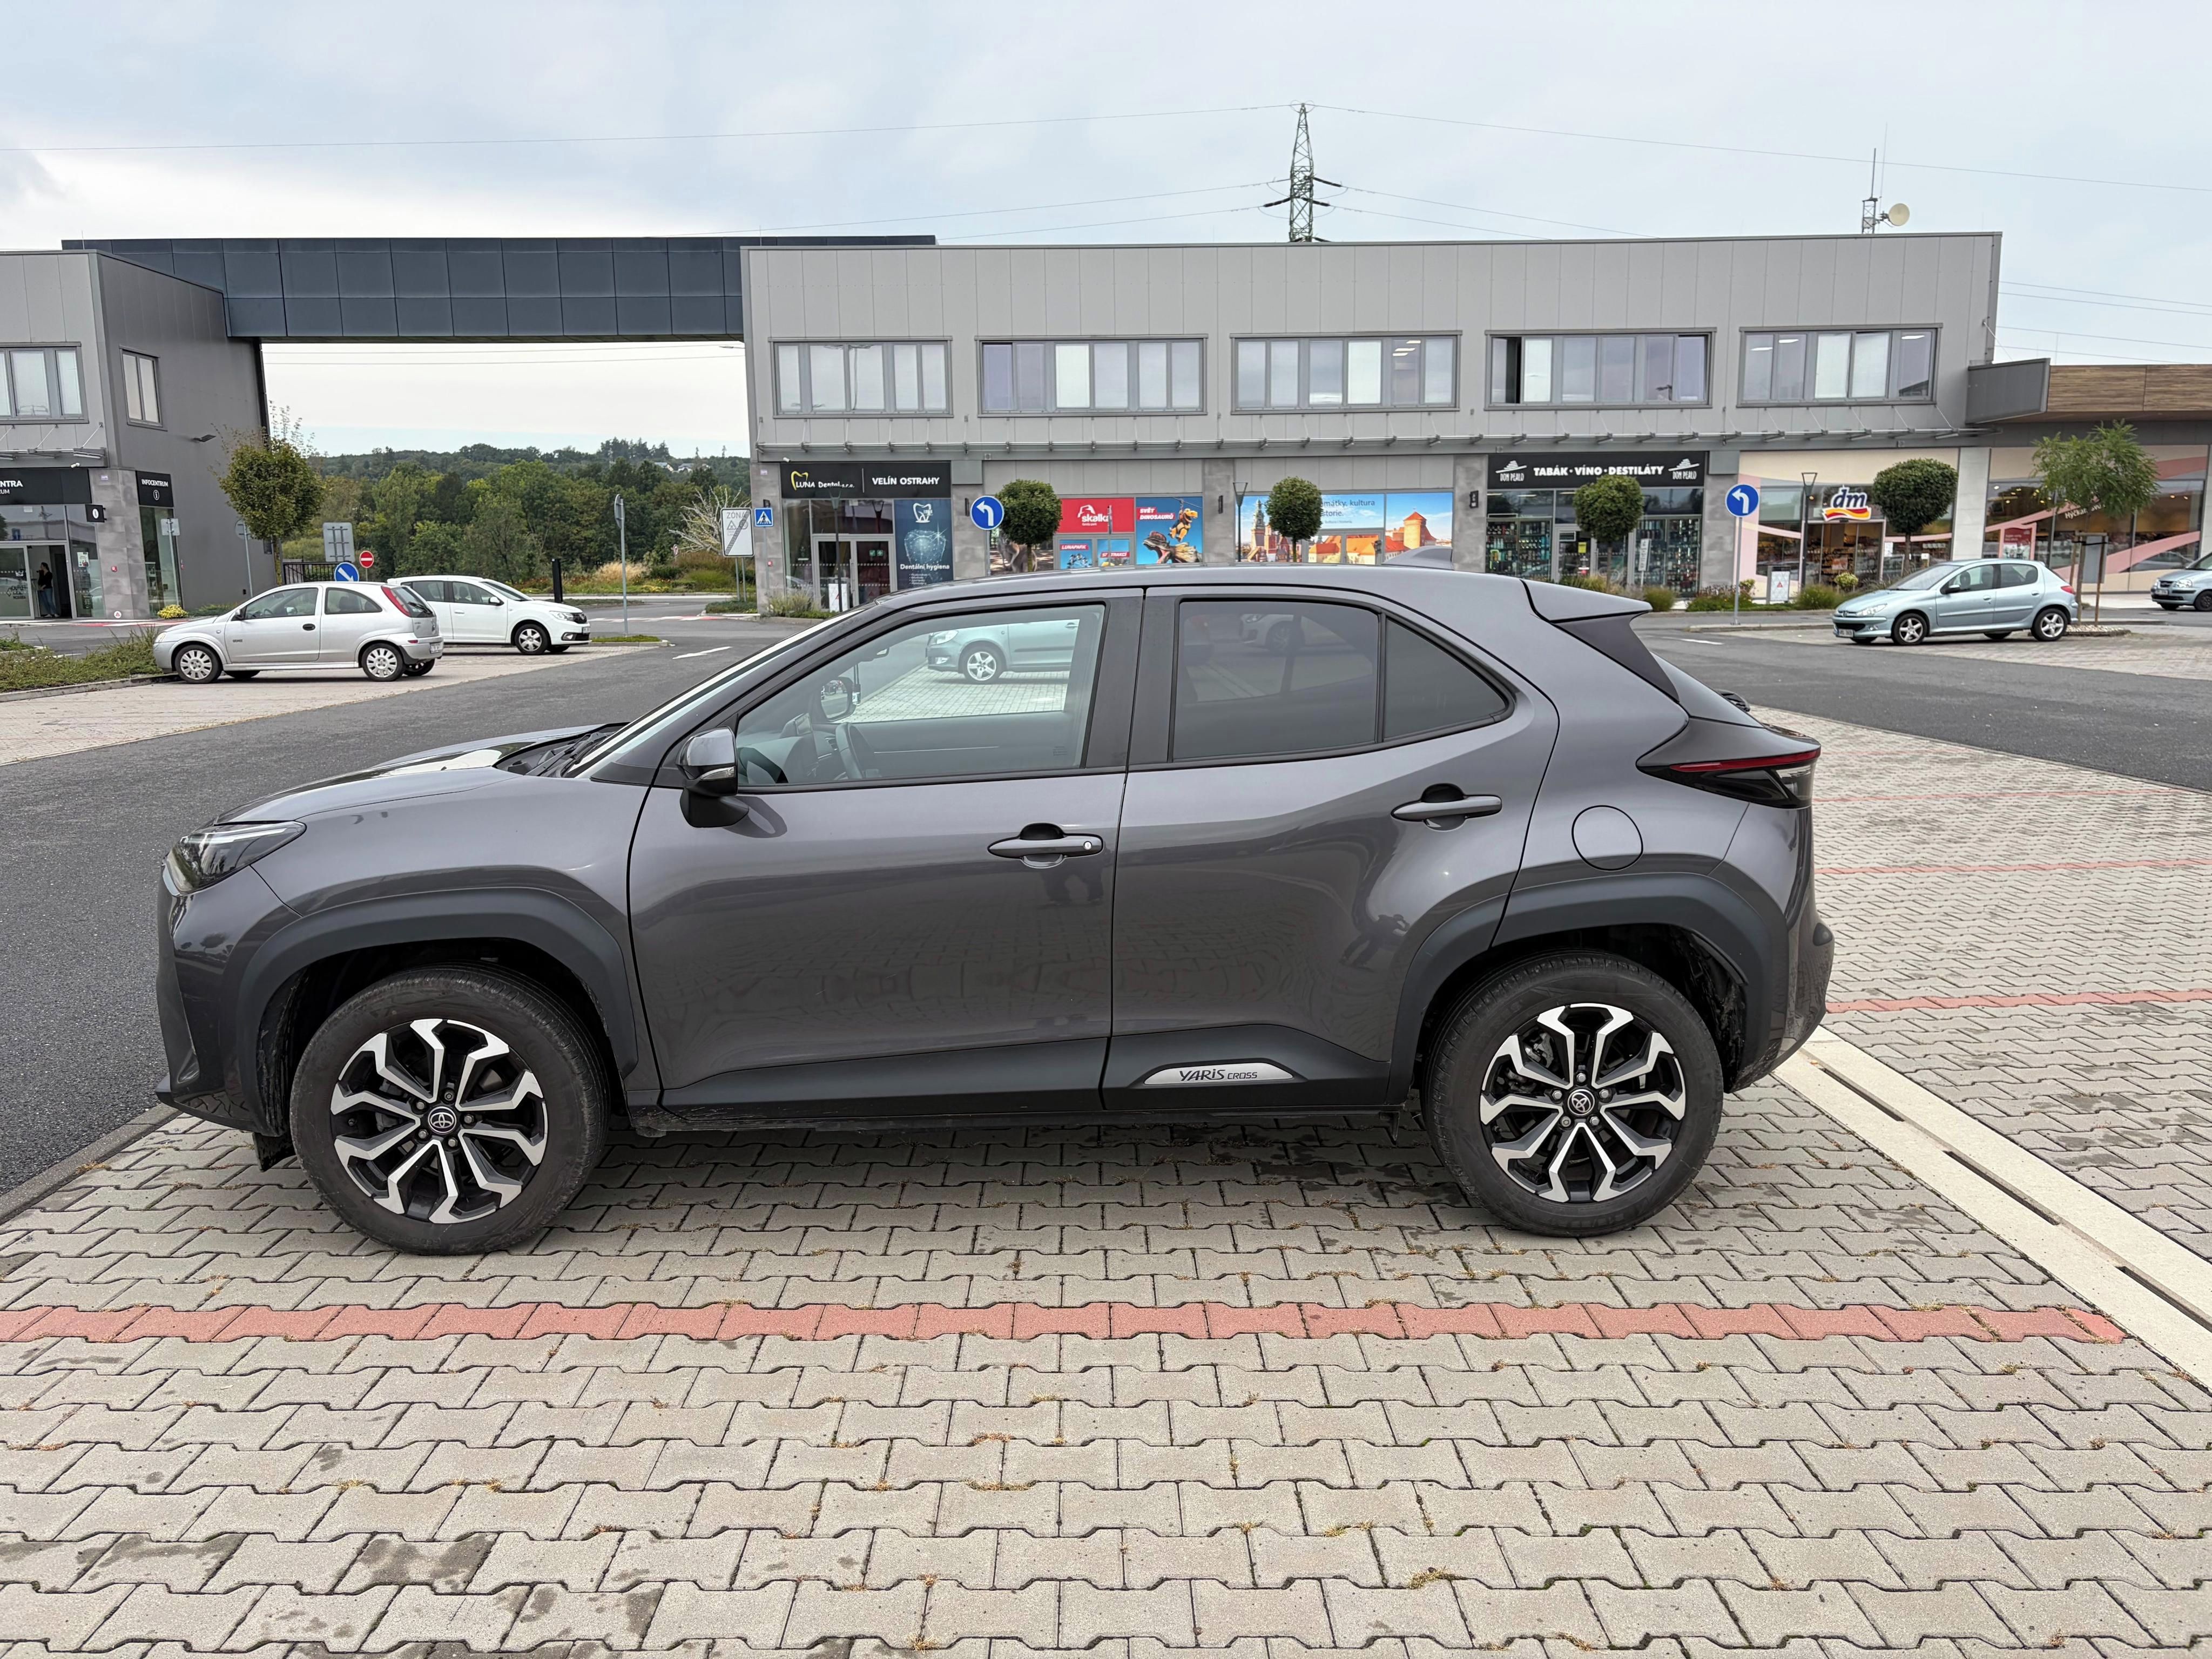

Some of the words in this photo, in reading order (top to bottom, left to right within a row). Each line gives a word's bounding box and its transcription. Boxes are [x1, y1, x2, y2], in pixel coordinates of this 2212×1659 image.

[1533, 464, 1568, 476] TABÁK
[1574, 464, 1603, 475] VÍNO
[1608, 463, 1664, 475] DESTILÁTY
[141, 478, 168, 487] INFOCENTRUM
[872, 476, 897, 485] VELÍN
[899, 477, 940, 485] OSTRAHY
[1833, 489, 1866, 508] dm
[926, 563, 950, 571] hygiena
[1227, 1071, 1257, 1080] CROSS
